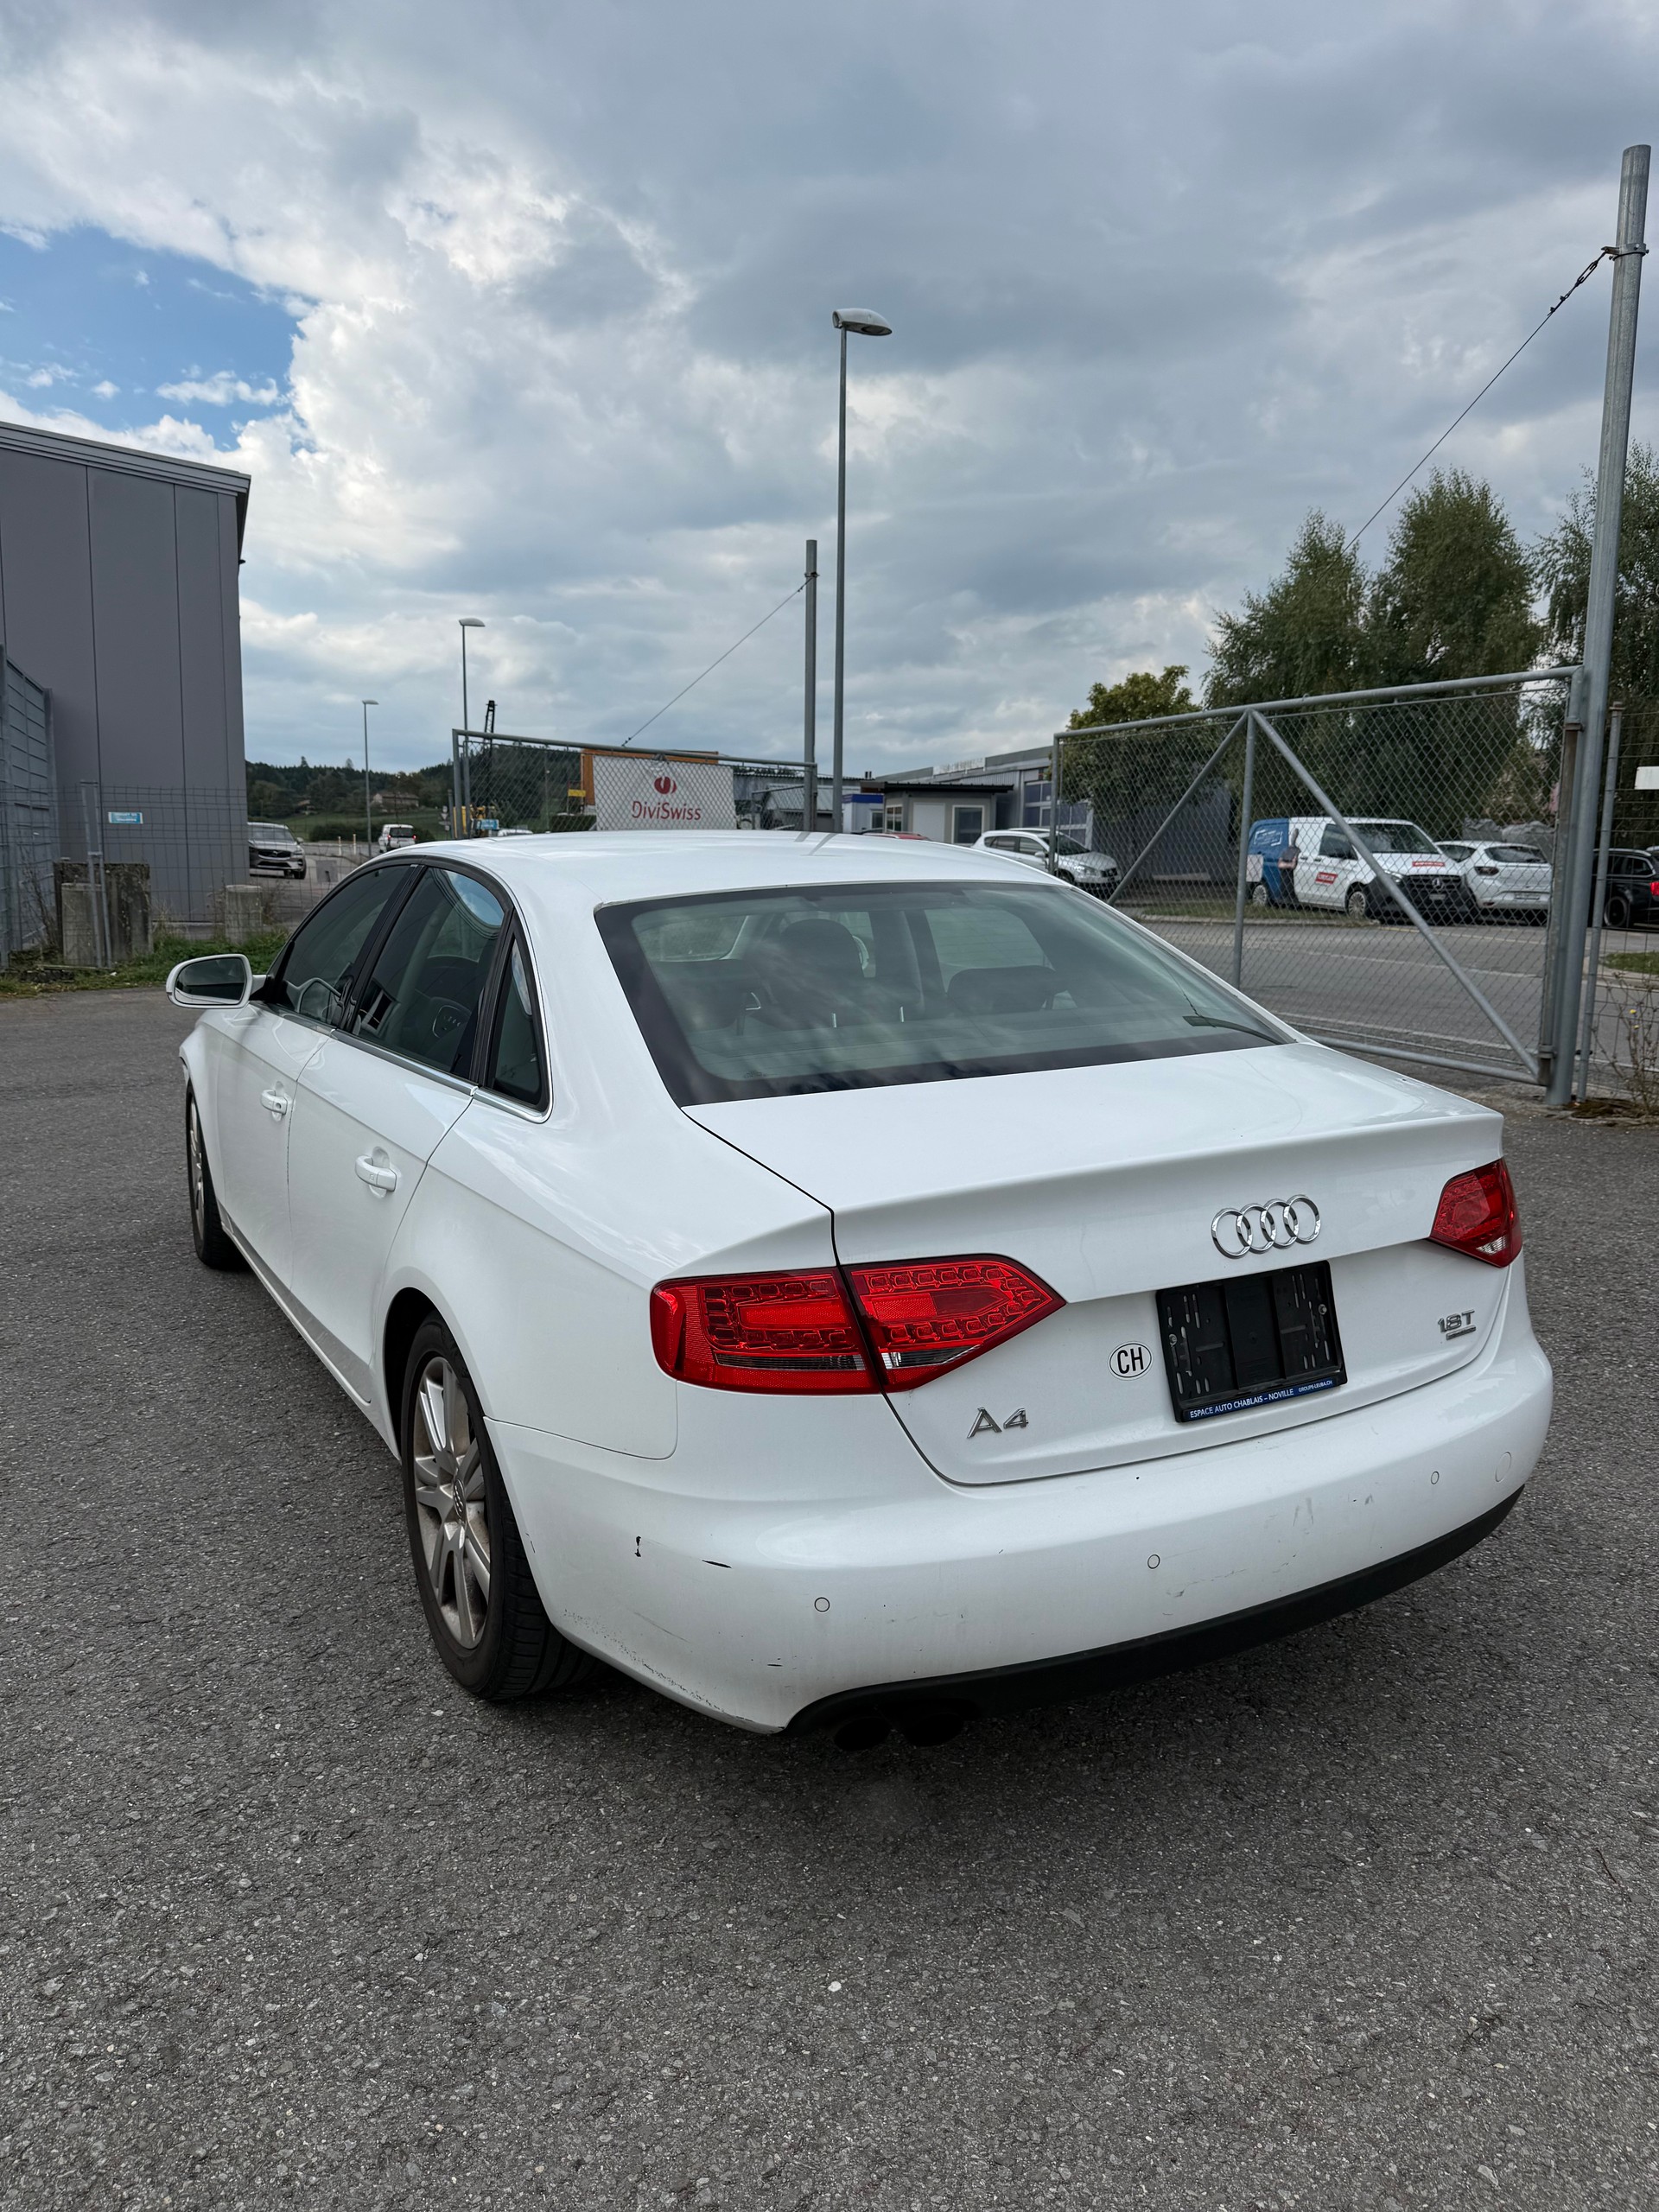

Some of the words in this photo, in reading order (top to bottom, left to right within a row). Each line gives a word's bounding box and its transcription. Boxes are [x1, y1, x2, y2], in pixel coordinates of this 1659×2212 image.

[632, 801, 701, 820] DiviSwiss
[1117, 1346, 1144, 1374] CH
[1190, 1407, 1213, 1419] ESPACE
[1214, 1402, 1233, 1415] AUTO
[1233, 1395, 1263, 1408] CHABLAIS
[1268, 1389, 1294, 1401] NOVILLE
[967, 1407, 1028, 1439] A4
